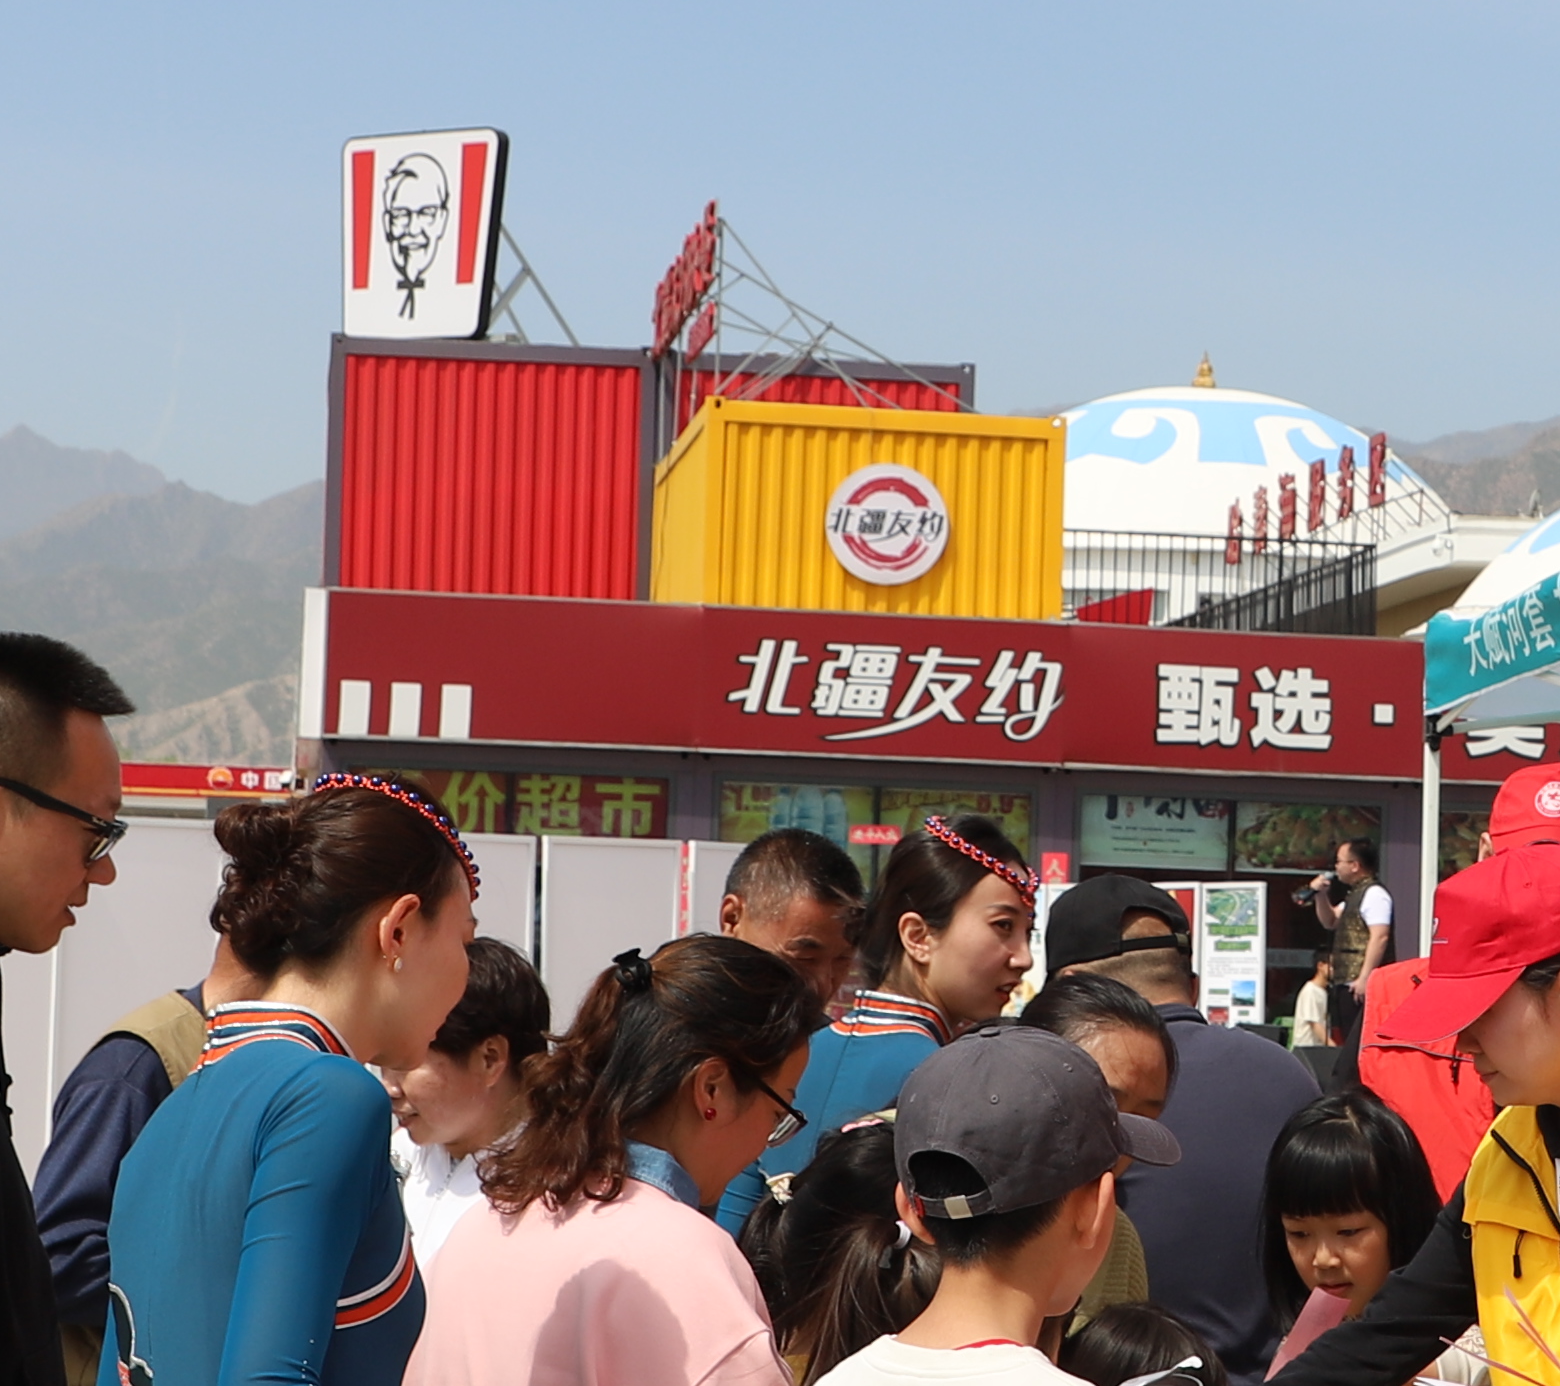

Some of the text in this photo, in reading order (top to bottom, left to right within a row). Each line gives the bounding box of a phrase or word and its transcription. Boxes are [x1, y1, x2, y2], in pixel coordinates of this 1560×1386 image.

[828, 507, 944, 543] 北疆友约
[727, 638, 1333, 751] 北疆友约 甄选
